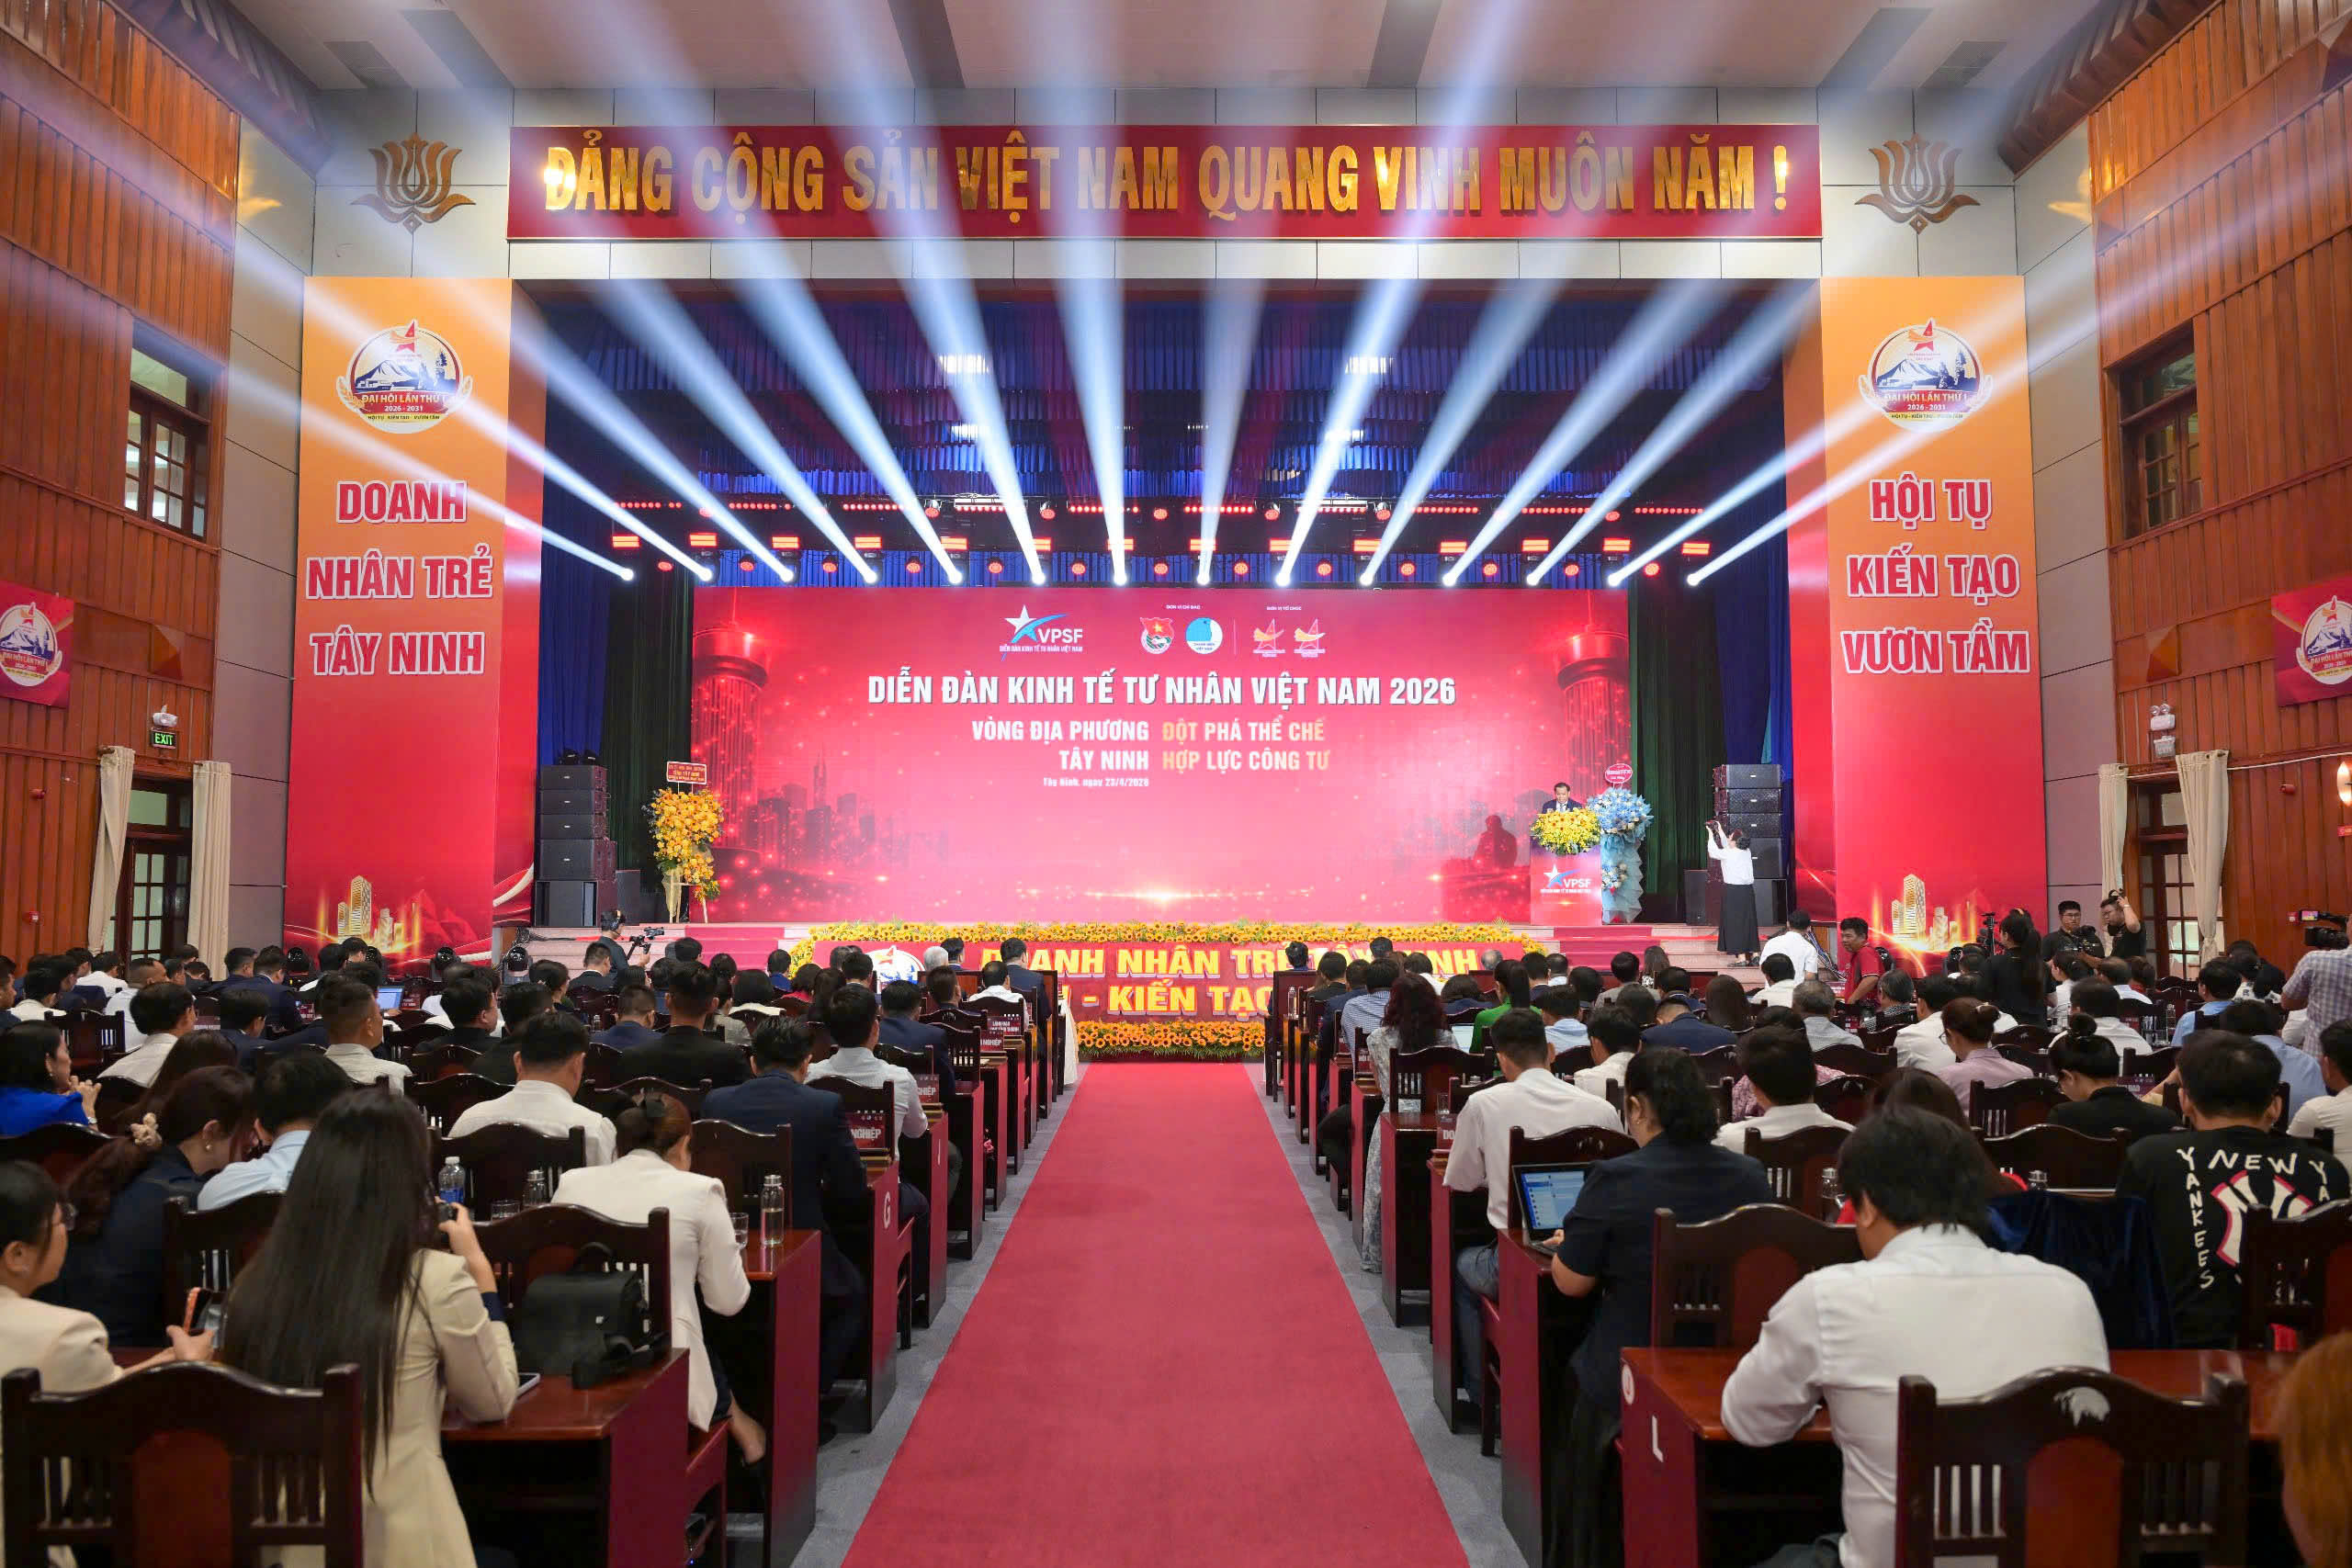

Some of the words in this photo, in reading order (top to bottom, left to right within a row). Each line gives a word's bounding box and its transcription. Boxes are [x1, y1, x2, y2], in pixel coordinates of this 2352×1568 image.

[545, 130, 672, 210] ĐẢNG
[691, 131, 823, 224] CỘNG
[842, 130, 939, 210] SẢN
[955, 130, 1059, 223] VIỆT
[1077, 145, 1179, 210] NAM
[1199, 144, 1359, 221] QUANG
[1374, 145, 1481, 210] VINH
[1499, 130, 1634, 210] MUÔN
[1654, 133, 1755, 210] NĂM
[1773, 145, 1788, 210] !
[337, 480, 467, 524] DOANH
[1870, 471, 1936, 529] HỘI
[1942, 479, 1992, 529] TỤ
[307, 548, 414, 599] NHÂN
[423, 543, 493, 598] TRẺ
[1847, 543, 1939, 597] KIẾN
[1945, 553, 2020, 605] TẠO
[310, 625, 382, 676] TÂY
[389, 632, 485, 675] NINH
[1038, 628, 1083, 643] VPSF
[1840, 626, 1943, 673] VƯƠN
[1947, 617, 2030, 673] TẦM
[868, 667, 932, 704] DIỄN
[941, 671, 1000, 704] ĐÀN
[1008, 676, 1074, 704] KINH
[1083, 668, 1116, 704] TẾ
[1124, 674, 1159, 704] TƯ
[1165, 671, 1243, 705] NHÂN
[1250, 671, 1308, 710] VIỆT
[1317, 677, 1380, 705] NAM
[1390, 677, 1456, 705] 2026
[154, 732, 174, 746] EXIT
[972, 716, 1024, 741] VÒNG
[1029, 720, 1064, 745] ĐỊA
[1069, 719, 1149, 741] PHƯƠNG
[1162, 718, 1198, 745] ĐỘT
[1204, 717, 1242, 741] PHÁ
[1288, 716, 1326, 741] CHẾ
[1059, 747, 1094, 770] TÂY
[1101, 750, 1149, 770] NINH
[1162, 749, 1200, 773] HỢP
[1207, 749, 1242, 773] LỰC
[1249, 747, 1300, 770] CÔNG
[1306, 749, 1331, 770] TƯ
[1564, 878, 1591, 888] VPSF
[980, 949, 1105, 976] DANH
[1117, 944, 1220, 977] NHÂN
[1108, 978, 1197, 1015] KIẾN
[2208, 1149, 2298, 1176] NEW
[2176, 1145, 2215, 1289] YANKEES
